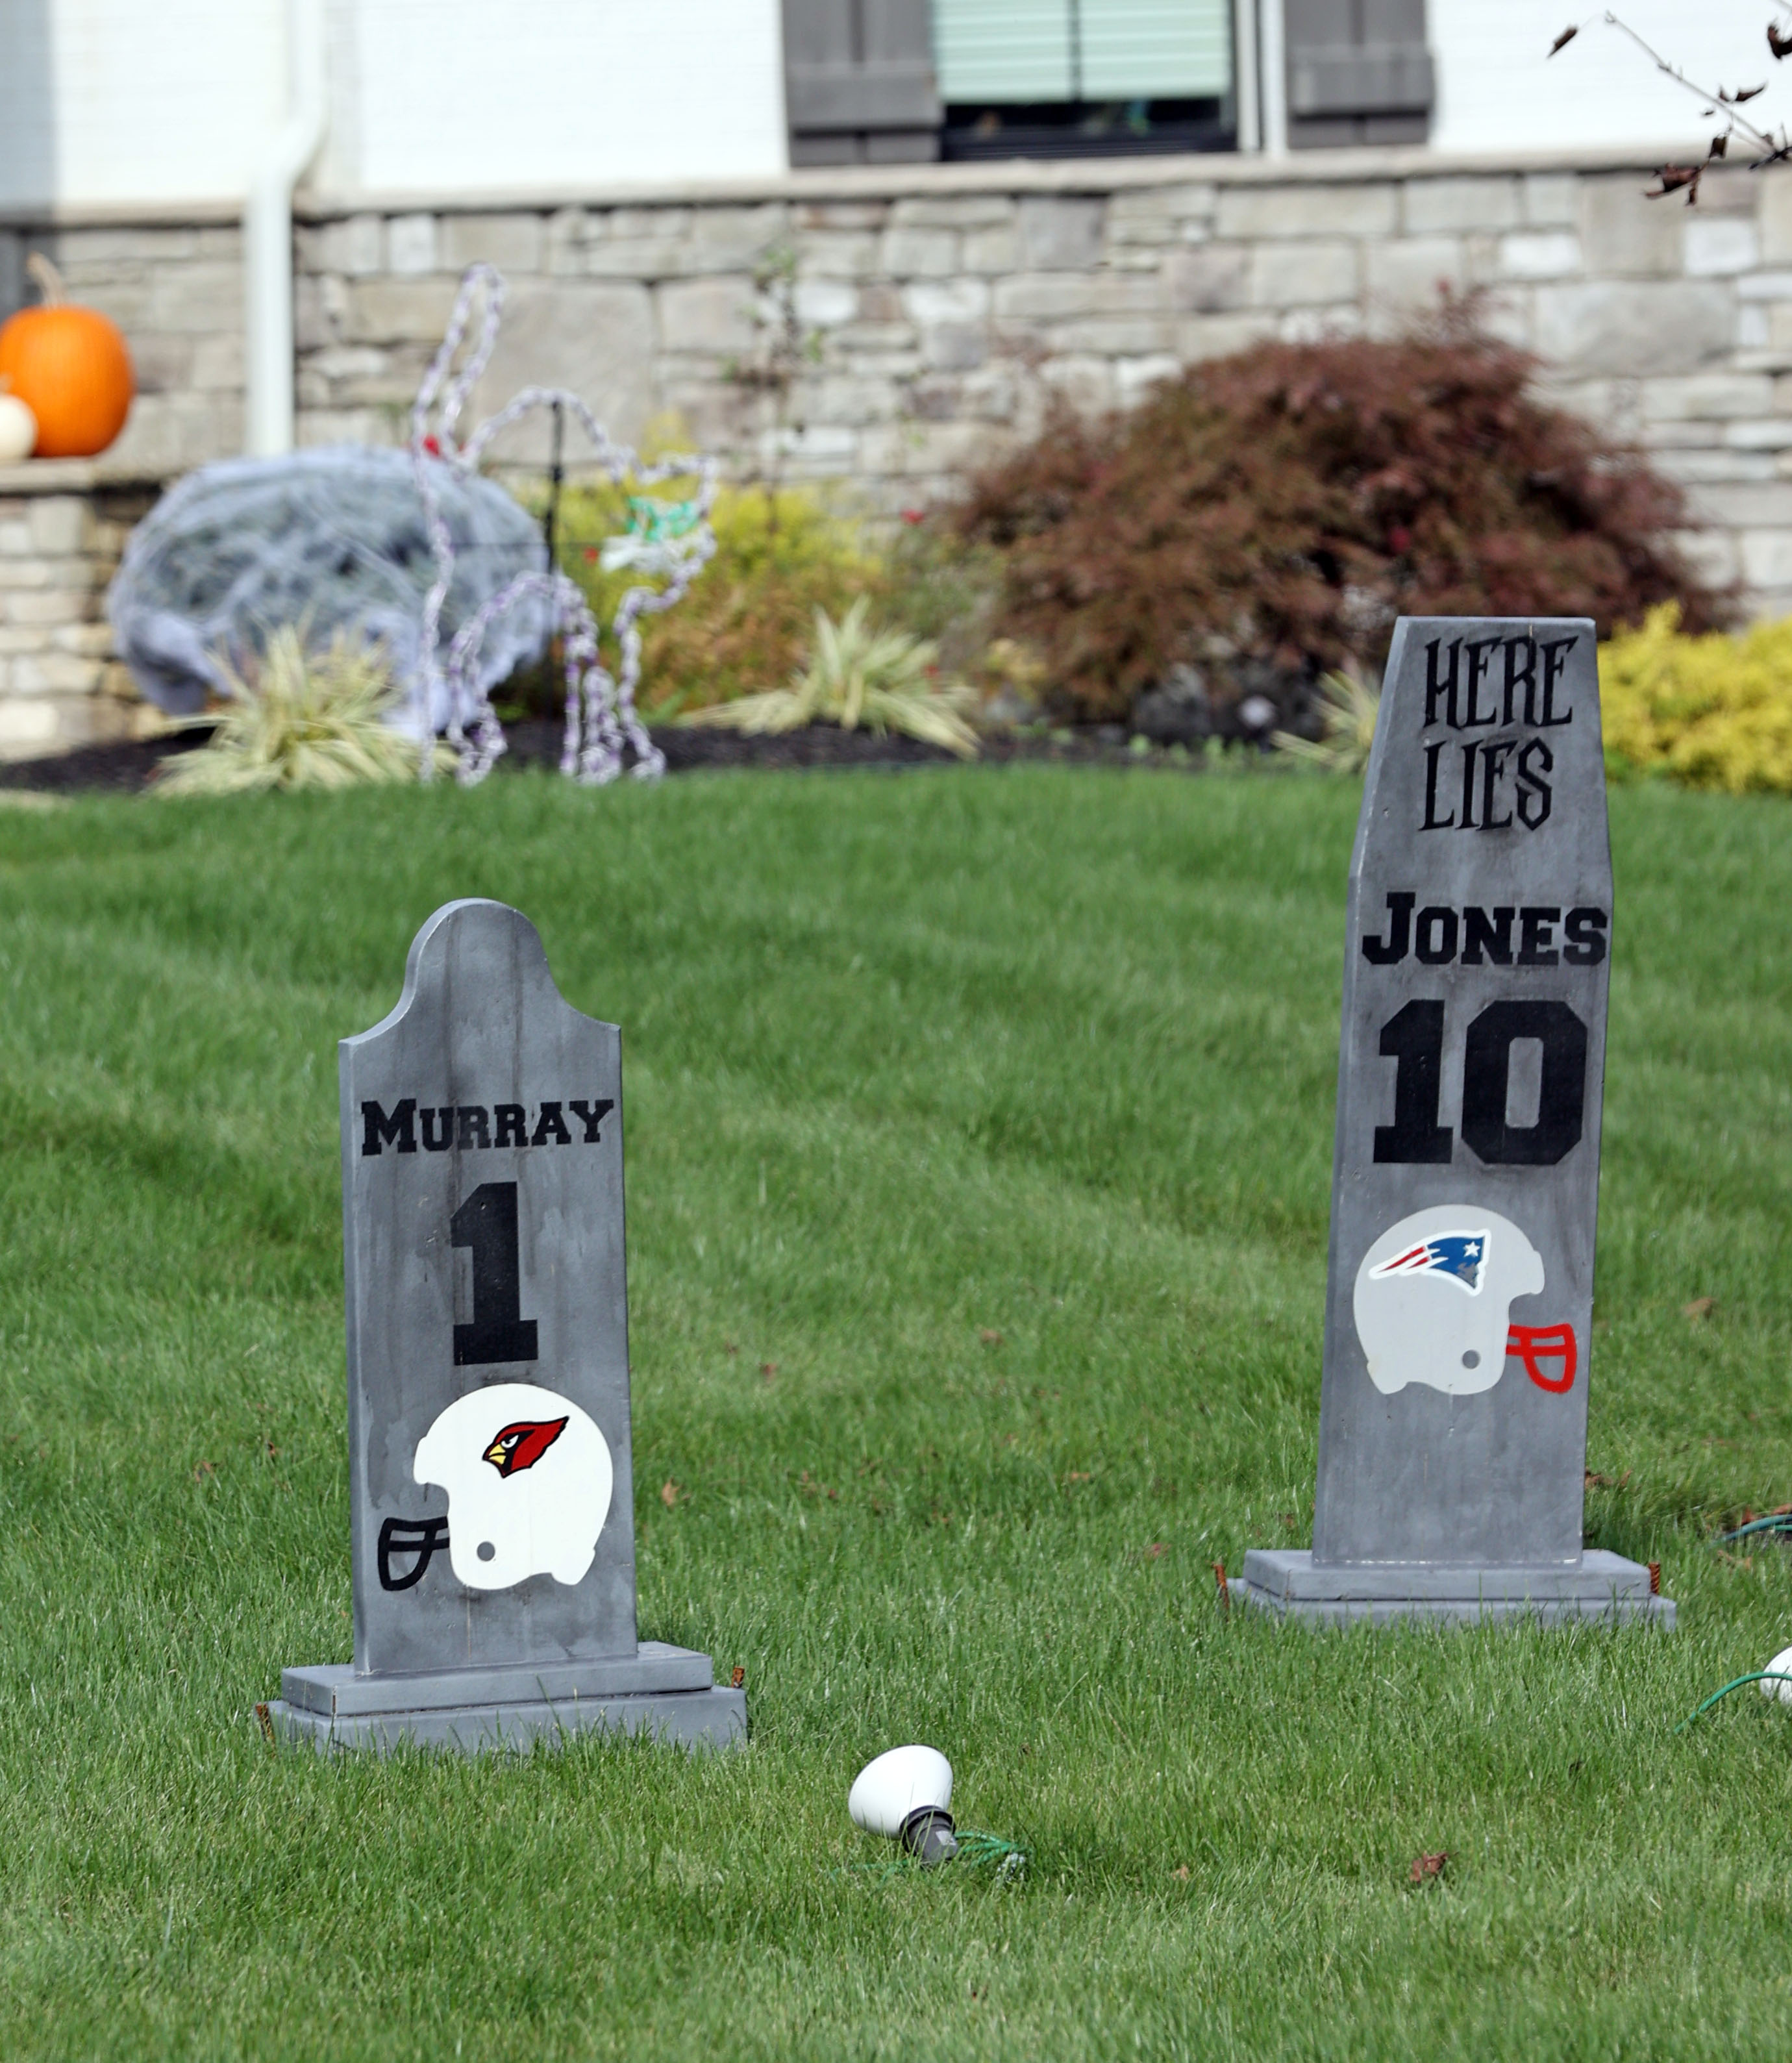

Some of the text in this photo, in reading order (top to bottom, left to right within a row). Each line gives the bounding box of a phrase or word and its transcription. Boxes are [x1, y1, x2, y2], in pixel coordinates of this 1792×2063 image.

[1423, 635, 1579, 731] HERE
[1418, 736, 1554, 831] LIES
[1373, 999, 1587, 1165] 10
[451, 1181, 538, 1366] 1
